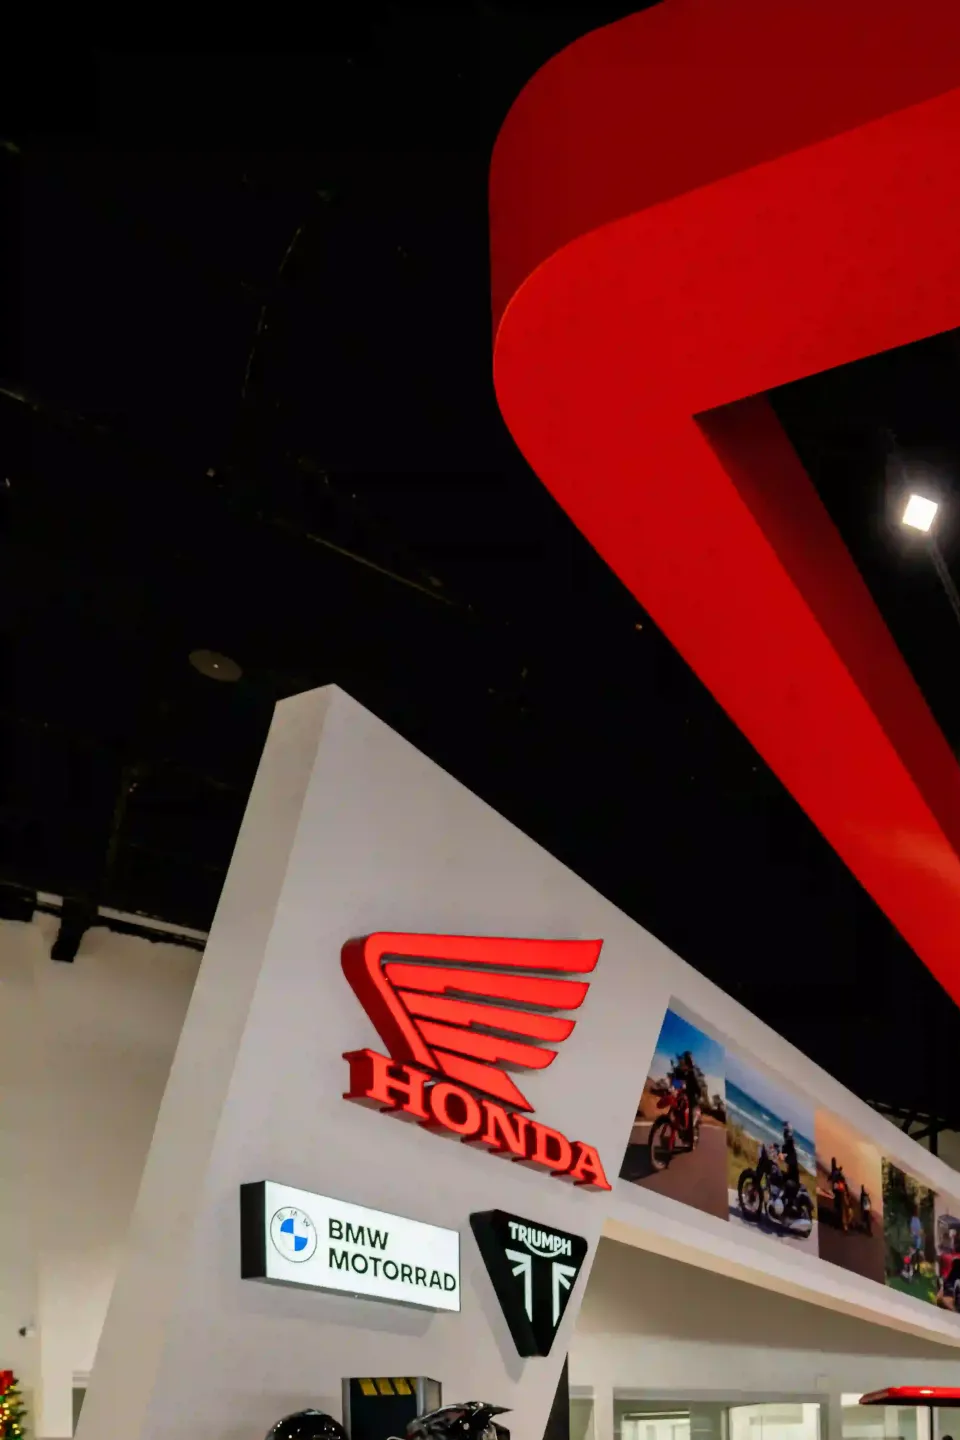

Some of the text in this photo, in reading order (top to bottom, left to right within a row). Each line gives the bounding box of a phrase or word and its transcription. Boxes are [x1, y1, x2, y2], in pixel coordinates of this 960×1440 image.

[350, 1048, 612, 1192] HONDA
[275, 1209, 311, 1228] BMW
[328, 1217, 389, 1250] BMW
[508, 1221, 572, 1257] TRIUMPH
[328, 1247, 457, 1291] MOTORRAD
